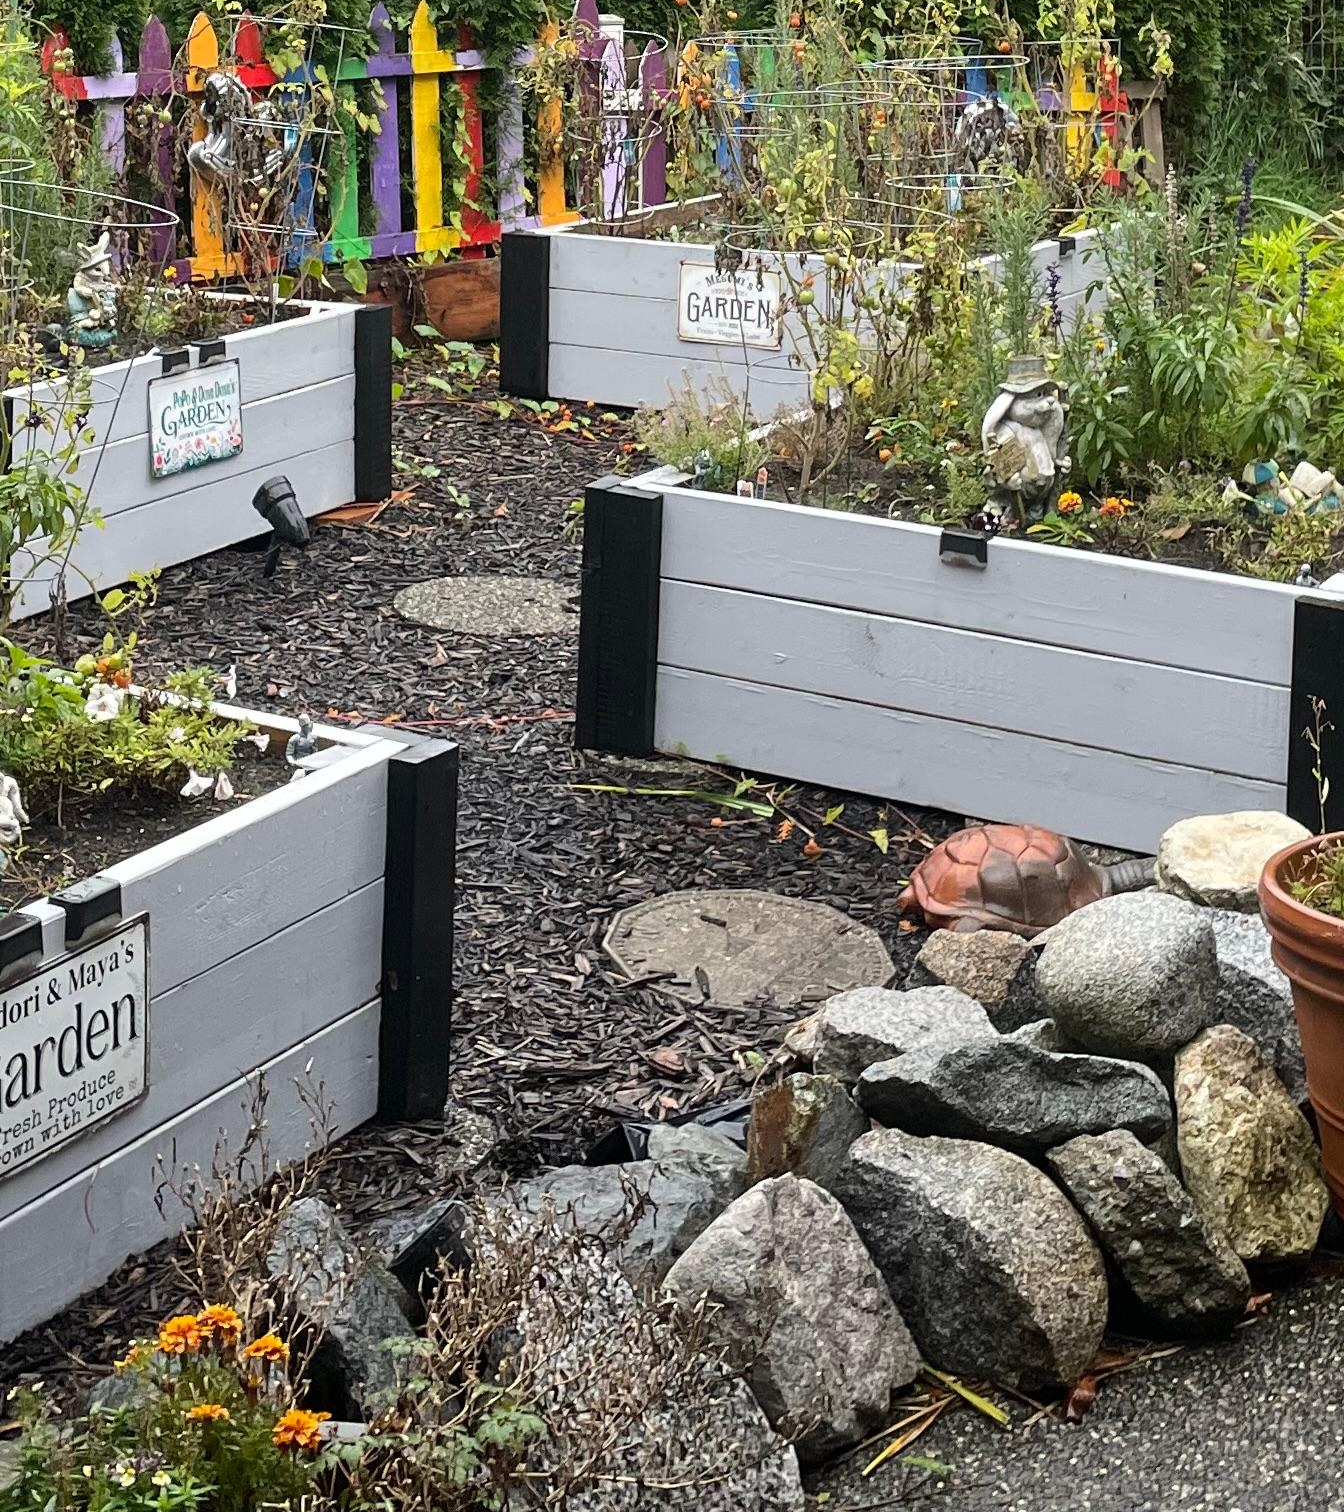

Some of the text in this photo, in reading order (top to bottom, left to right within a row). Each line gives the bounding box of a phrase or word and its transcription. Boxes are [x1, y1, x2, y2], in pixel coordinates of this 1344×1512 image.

[687, 292, 771, 329] GARDEN
[161, 400, 231, 439] GARDEN
[46, 977, 62, 1006] &
[67, 940, 135, 995] Maya's
[40, 1109, 82, 1142] with
[86, 1087, 124, 1118] love
[47, 1069, 116, 1119] Produce
